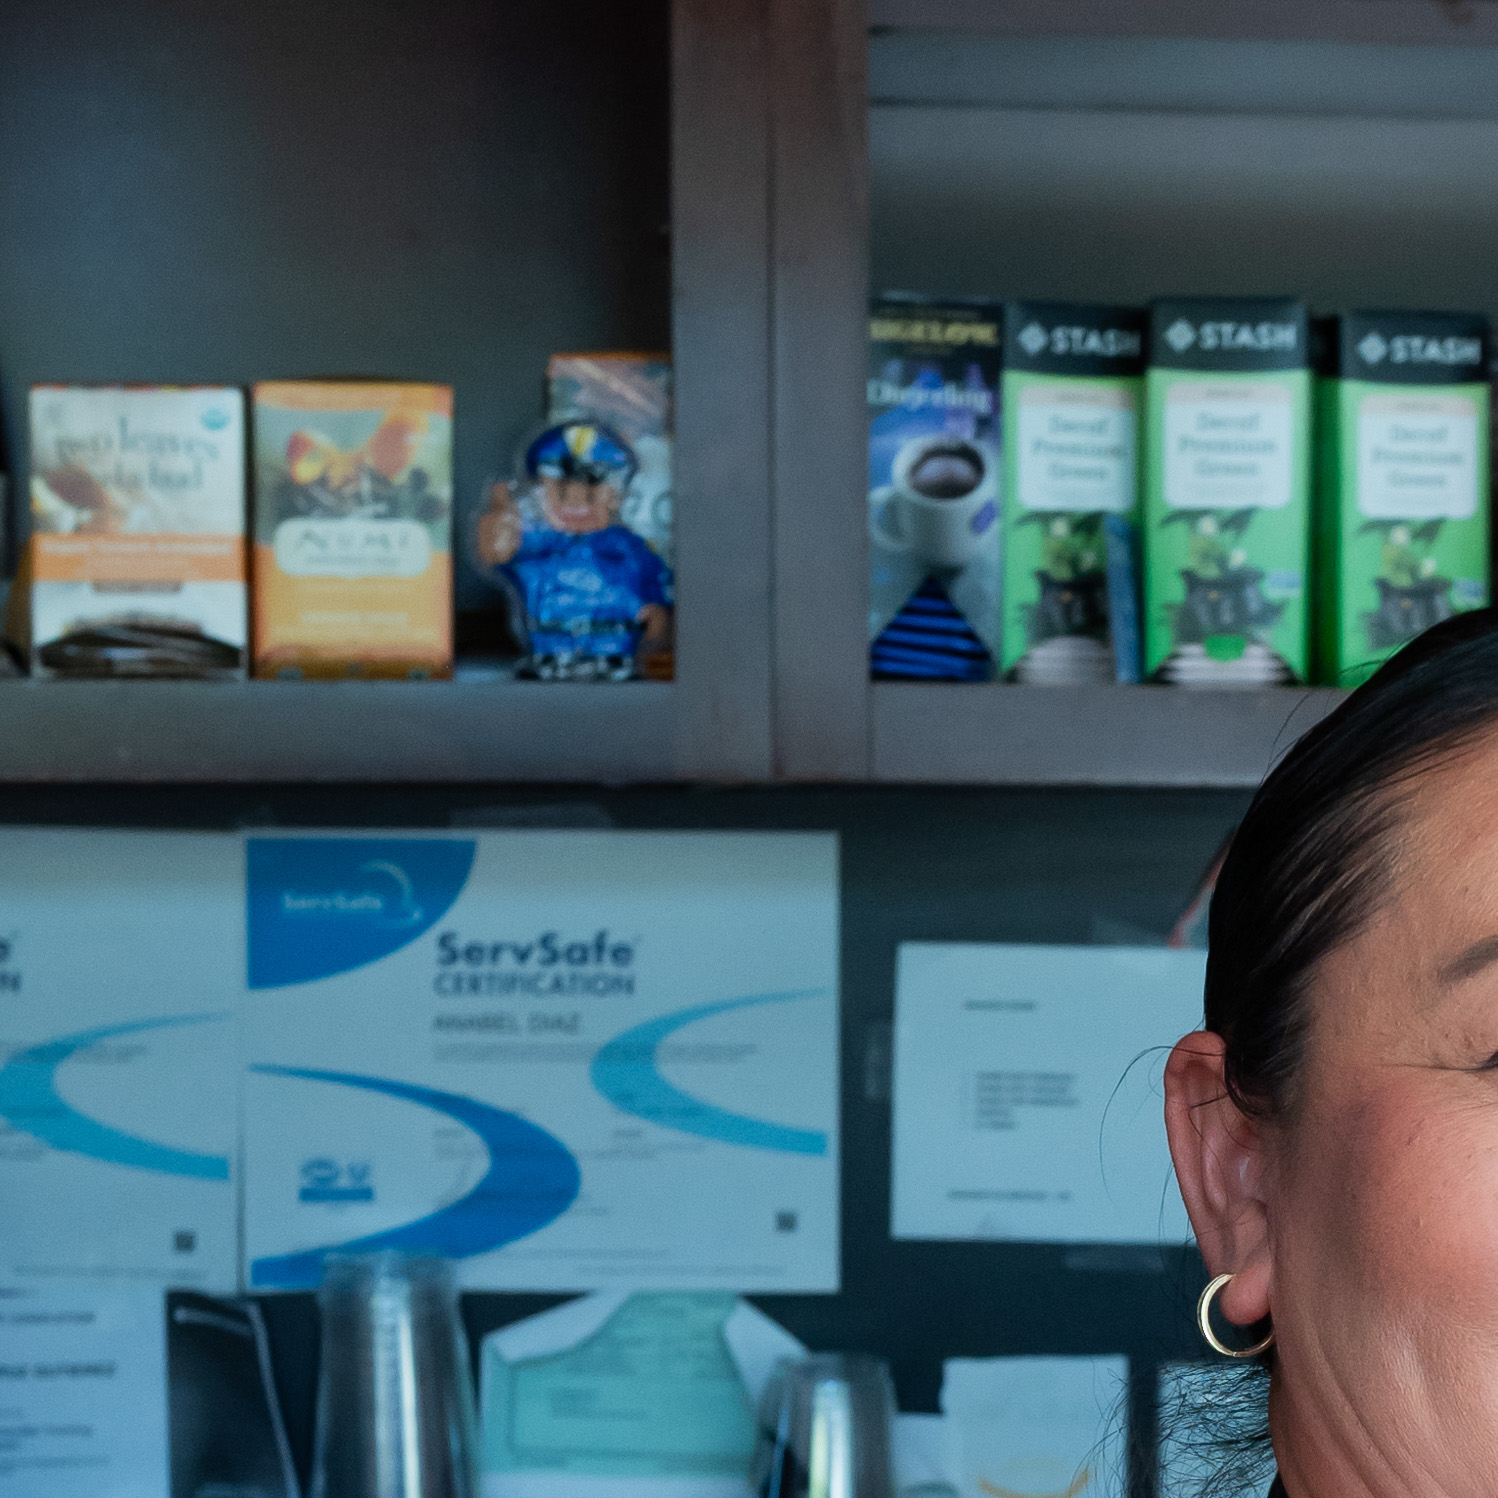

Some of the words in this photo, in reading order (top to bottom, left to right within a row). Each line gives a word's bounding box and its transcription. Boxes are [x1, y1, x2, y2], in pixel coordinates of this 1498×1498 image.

[1050, 325, 1142, 356] STASH
[1198, 320, 1298, 350] STASH
[1389, 335, 1482, 365] STASH
[437, 927, 635, 969] ServSafe
[433, 970, 636, 998] CERTIFICATION
